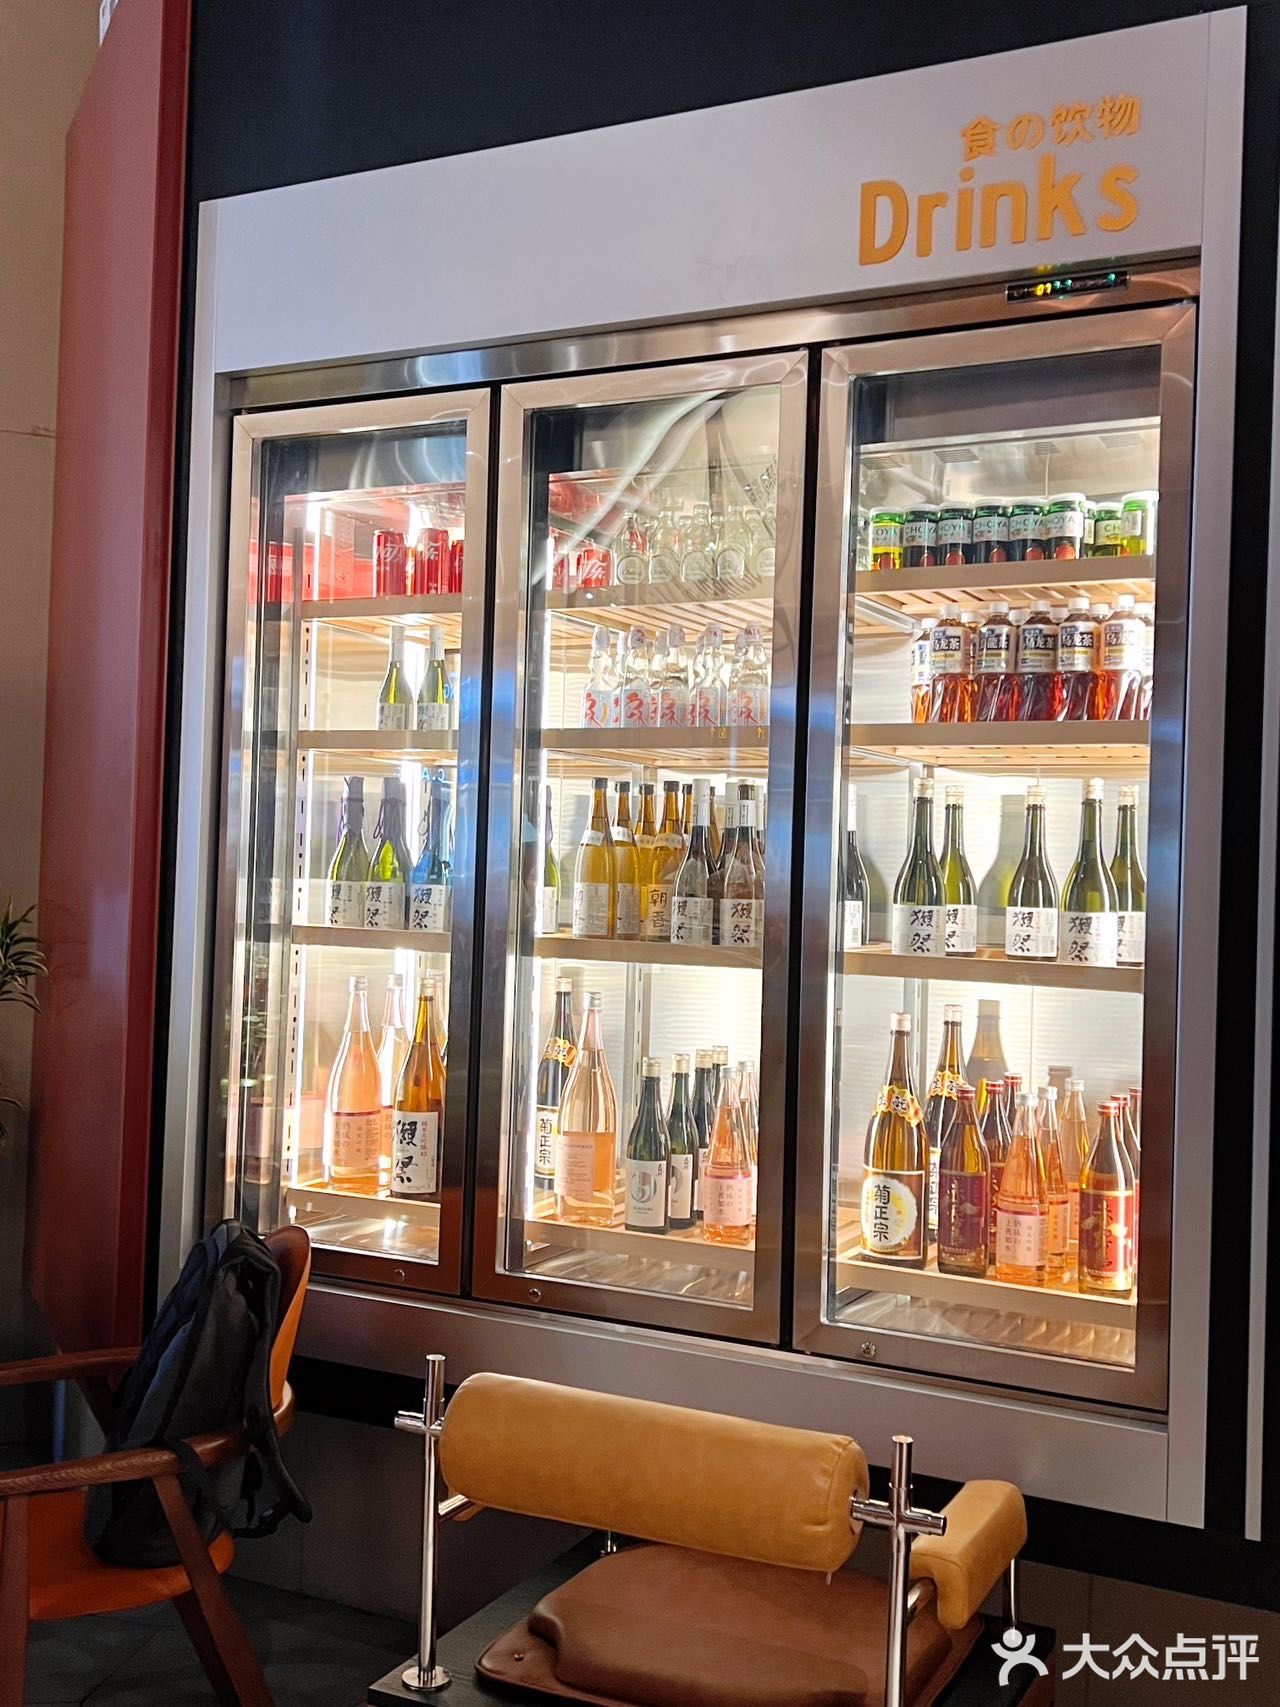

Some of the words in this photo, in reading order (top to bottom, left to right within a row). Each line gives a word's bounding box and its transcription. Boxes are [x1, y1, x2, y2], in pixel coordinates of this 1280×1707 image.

[961, 94, 1141, 162] 食の饮物
[859, 154, 1139, 266] Drinks
[873, 1183, 892, 1243] 菊正宗
